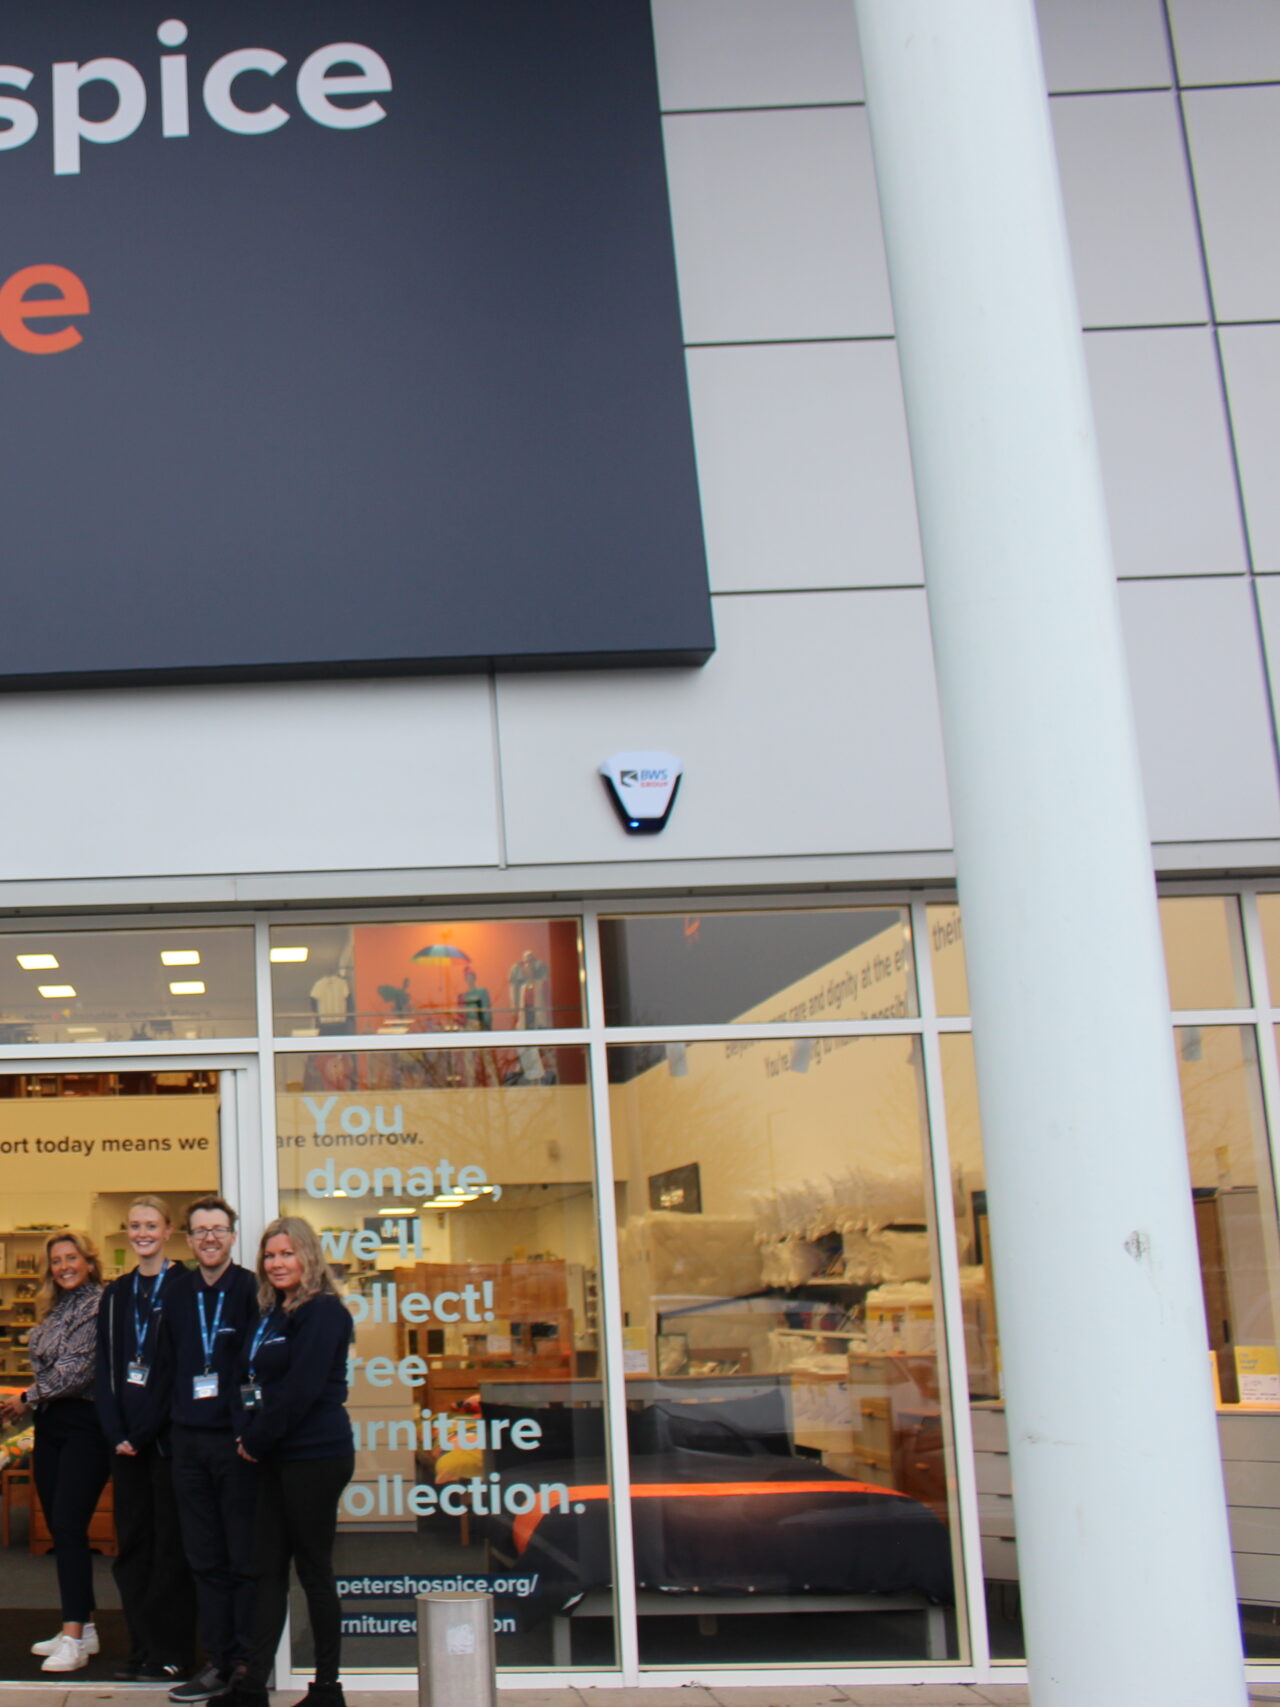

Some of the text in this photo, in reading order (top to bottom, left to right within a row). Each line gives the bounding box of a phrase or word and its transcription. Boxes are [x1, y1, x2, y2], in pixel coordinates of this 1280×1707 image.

[640, 768, 669, 780] BWS
[300, 1095, 405, 1136] You
[35, 1136, 96, 1157] today
[102, 1137, 172, 1152] means
[178, 1137, 210, 1151] we
[275, 1134, 307, 1149] are
[312, 1130, 424, 1148] tomorrow.
[304, 1158, 503, 1202] donate,
[341, 1281, 496, 1325] ollect!
[345, 1354, 429, 1388] ree
[353, 1408, 543, 1451] rniture
[336, 1472, 587, 1517] ollection.
[335, 1573, 540, 1598] petershospice.org/
